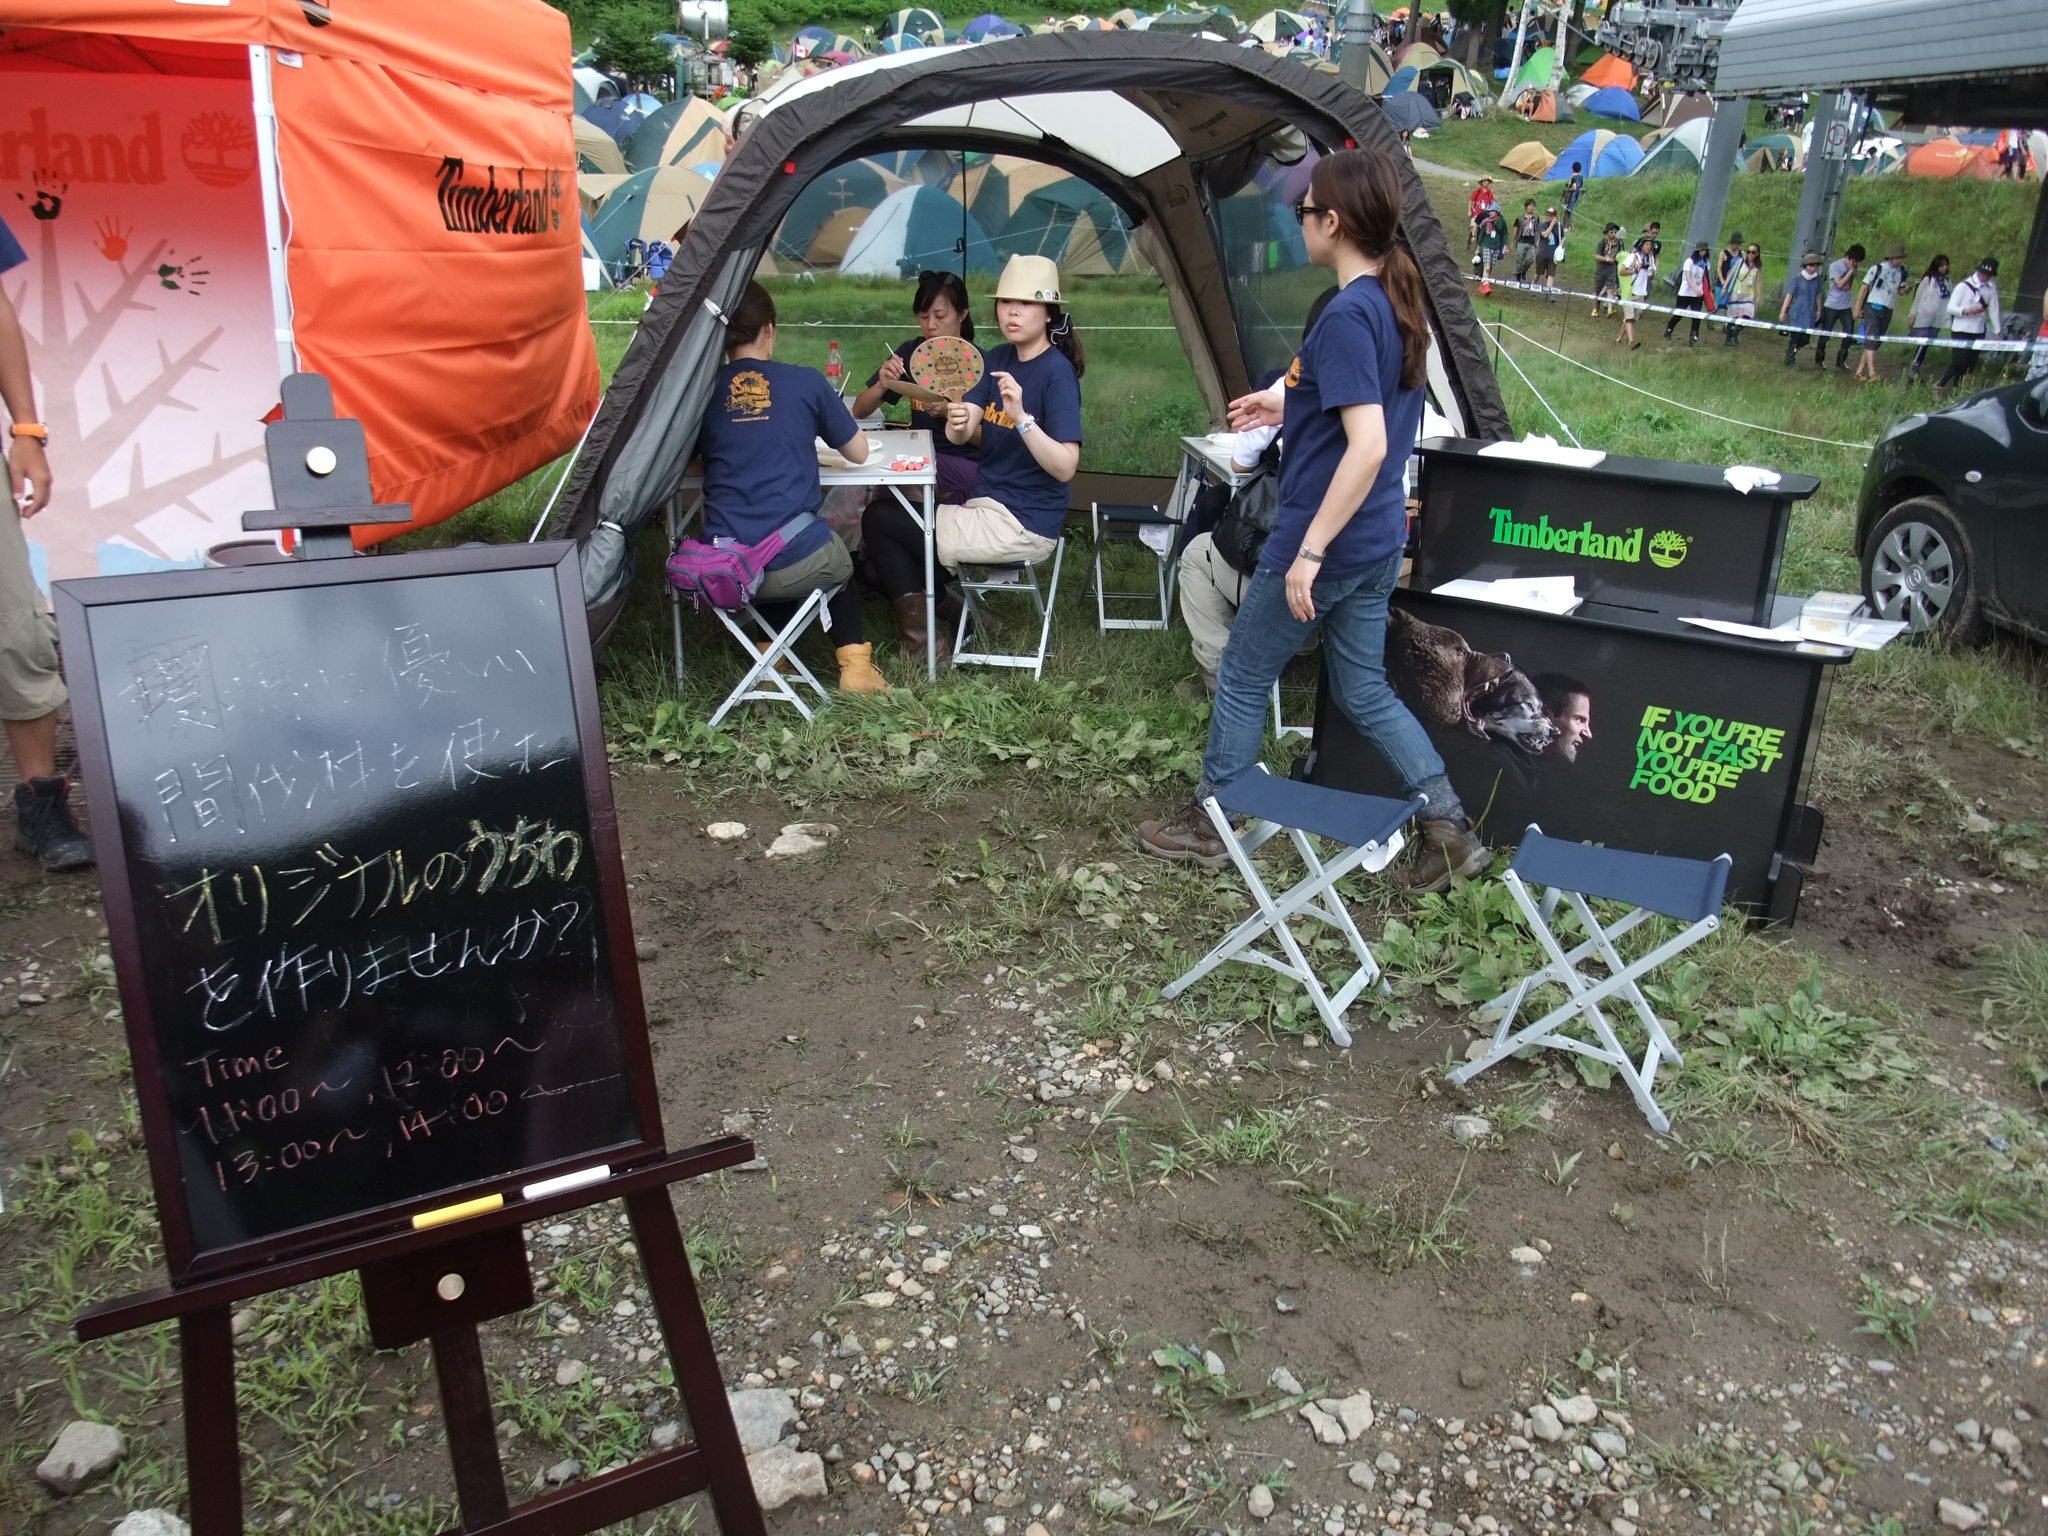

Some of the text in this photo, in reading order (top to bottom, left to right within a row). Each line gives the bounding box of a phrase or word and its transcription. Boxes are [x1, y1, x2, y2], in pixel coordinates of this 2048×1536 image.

[0, 106, 167, 186] rland
[435, 154, 549, 235] Timberland
[1489, 507, 1644, 563] Timberland
[1636, 727, 1784, 773] NOT FAST
[1640, 705, 1786, 752] IF YOU'RE
[1629, 768, 1718, 805] FOOD
[1635, 746, 1744, 790] YOU'RE
[163, 815, 583, 945] オリジナルのうちわ
[186, 1045, 291, 1088] Time
